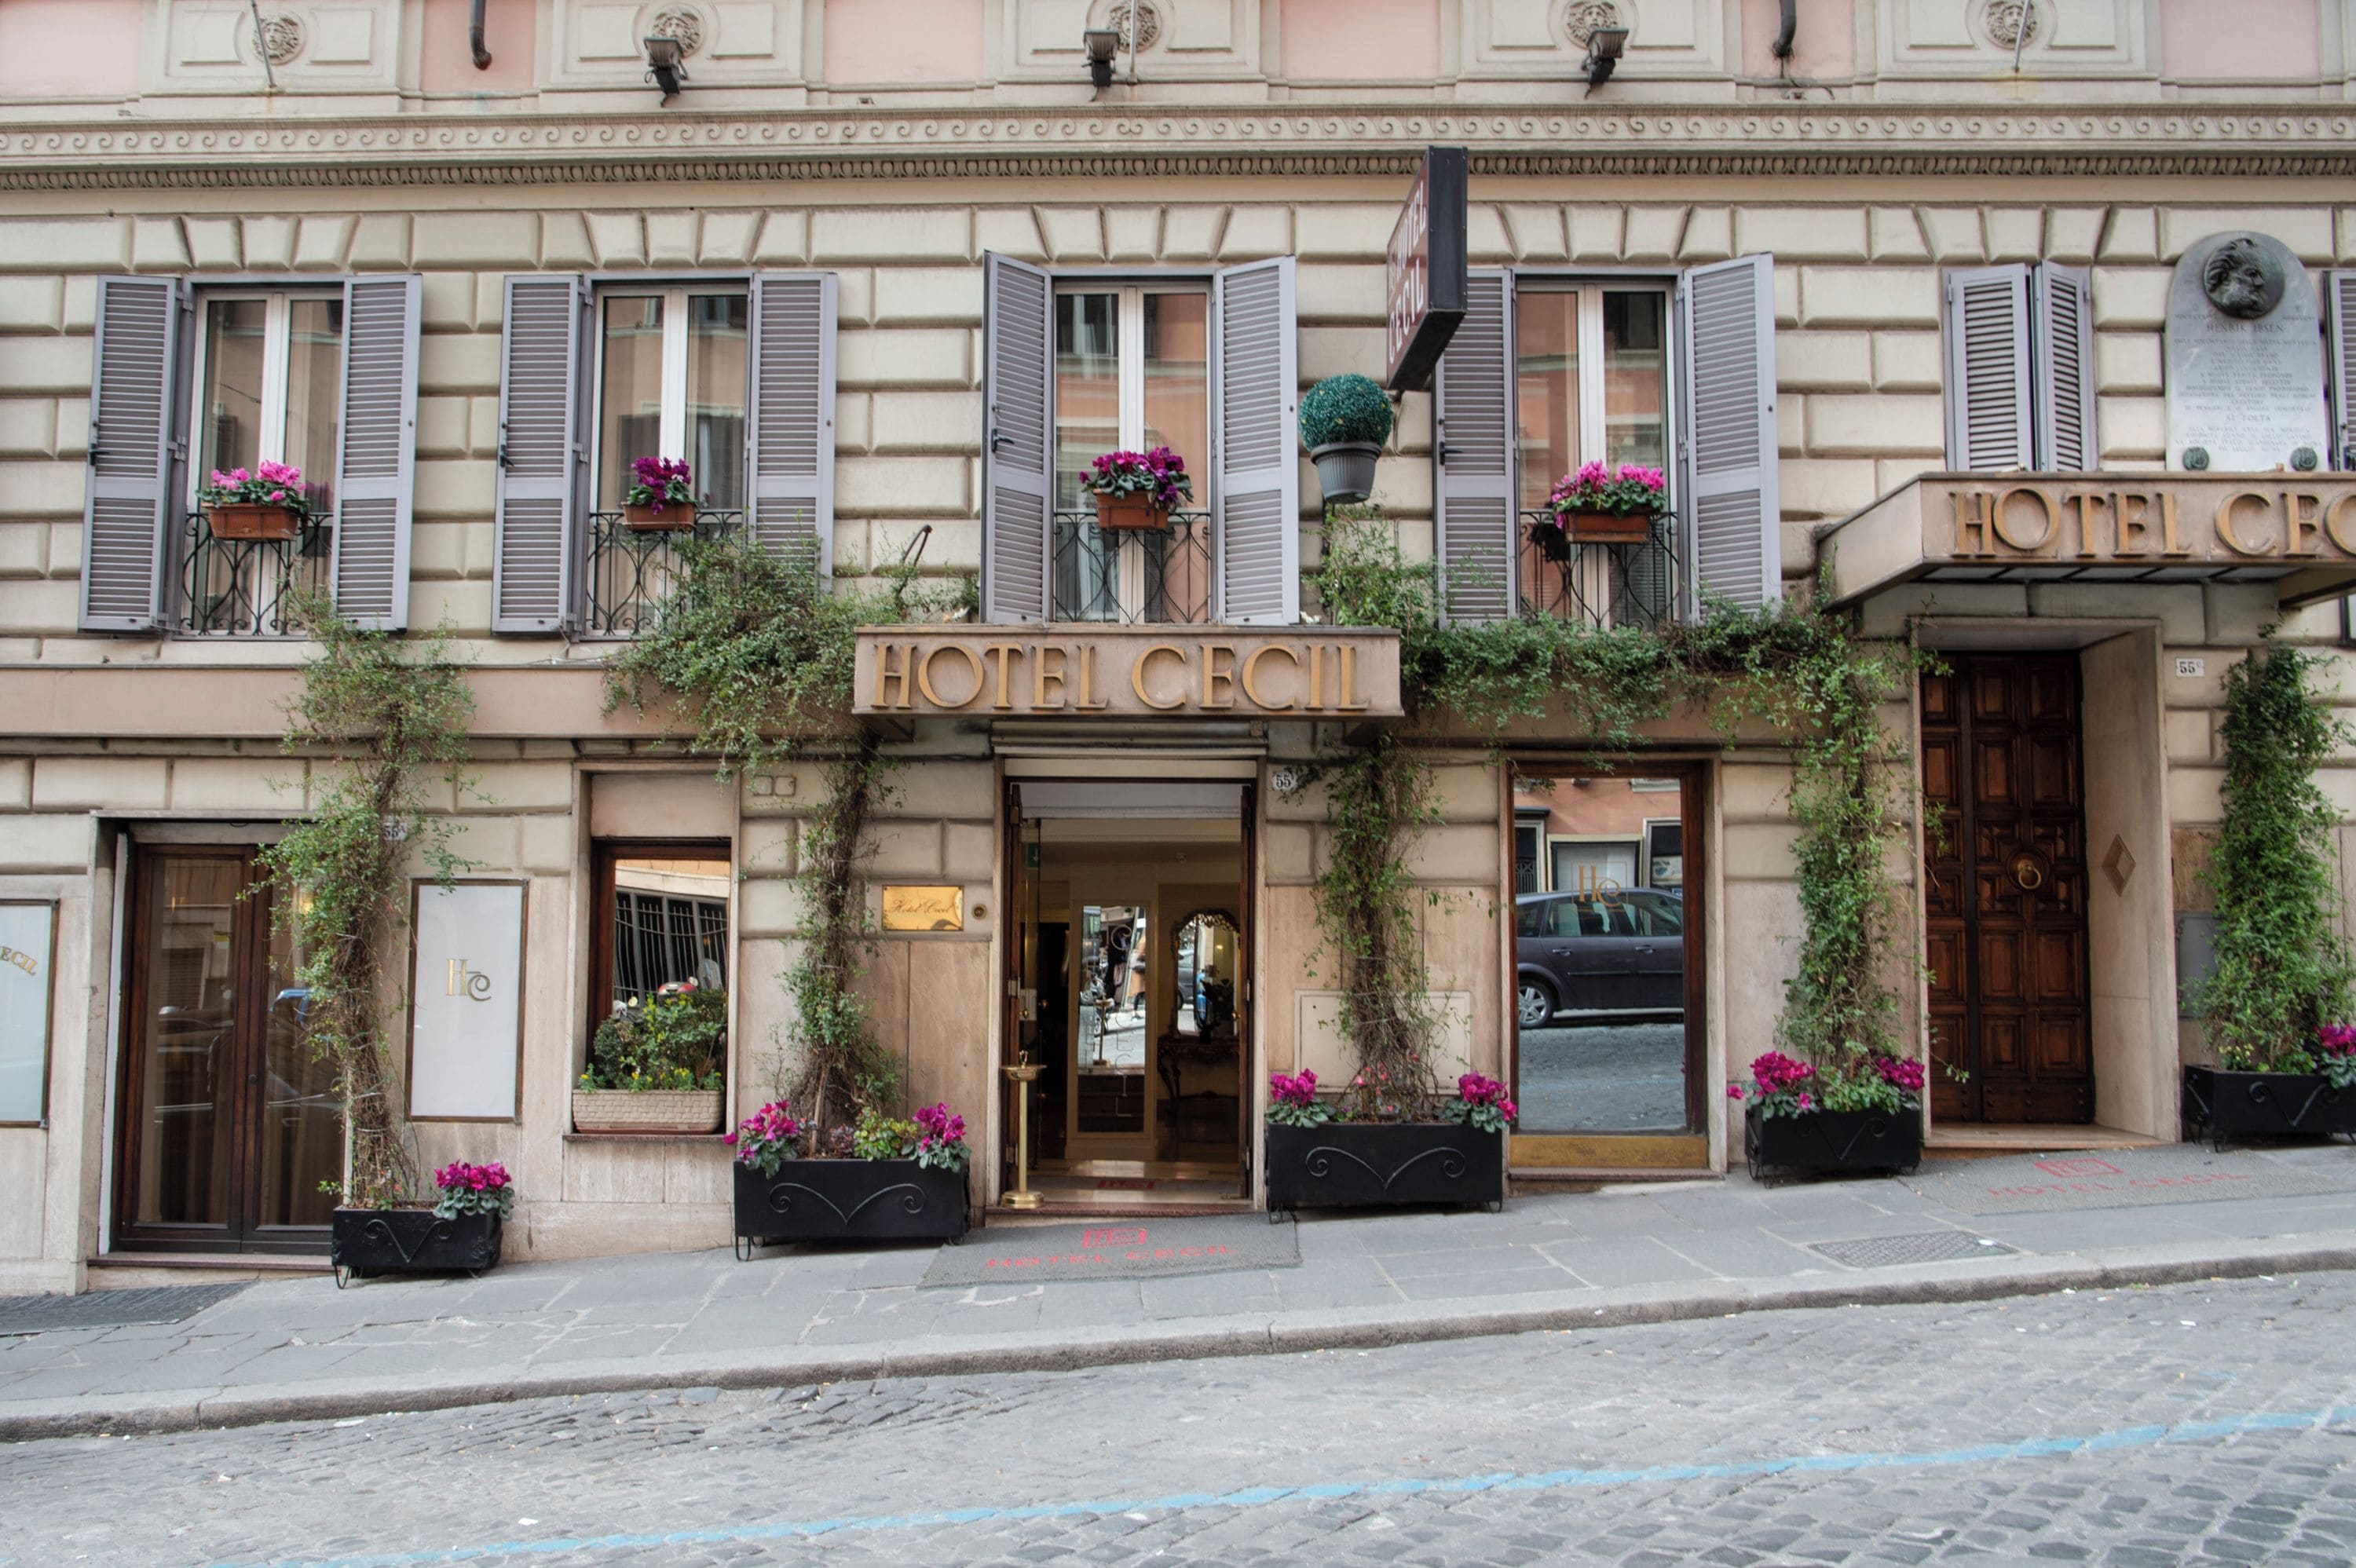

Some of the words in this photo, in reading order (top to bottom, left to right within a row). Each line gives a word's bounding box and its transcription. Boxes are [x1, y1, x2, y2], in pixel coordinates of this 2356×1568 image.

[1396, 180, 1426, 283] HOTEL
[1389, 258, 1424, 364] CECIL
[2207, 323, 2247, 333] HENRIK
[2254, 323, 2285, 333] IBSEN
[1948, 487, 2193, 557] HOTEL
[869, 641, 1109, 710] HOTEL
[1131, 643, 1371, 711] CECIL
[1986, 1183, 2121, 1196] HOTEL
[2129, 1172, 2251, 1189] CECIL
[986, 1253, 1114, 1269] HOTEL
[1124, 1244, 1238, 1261] CECIL
